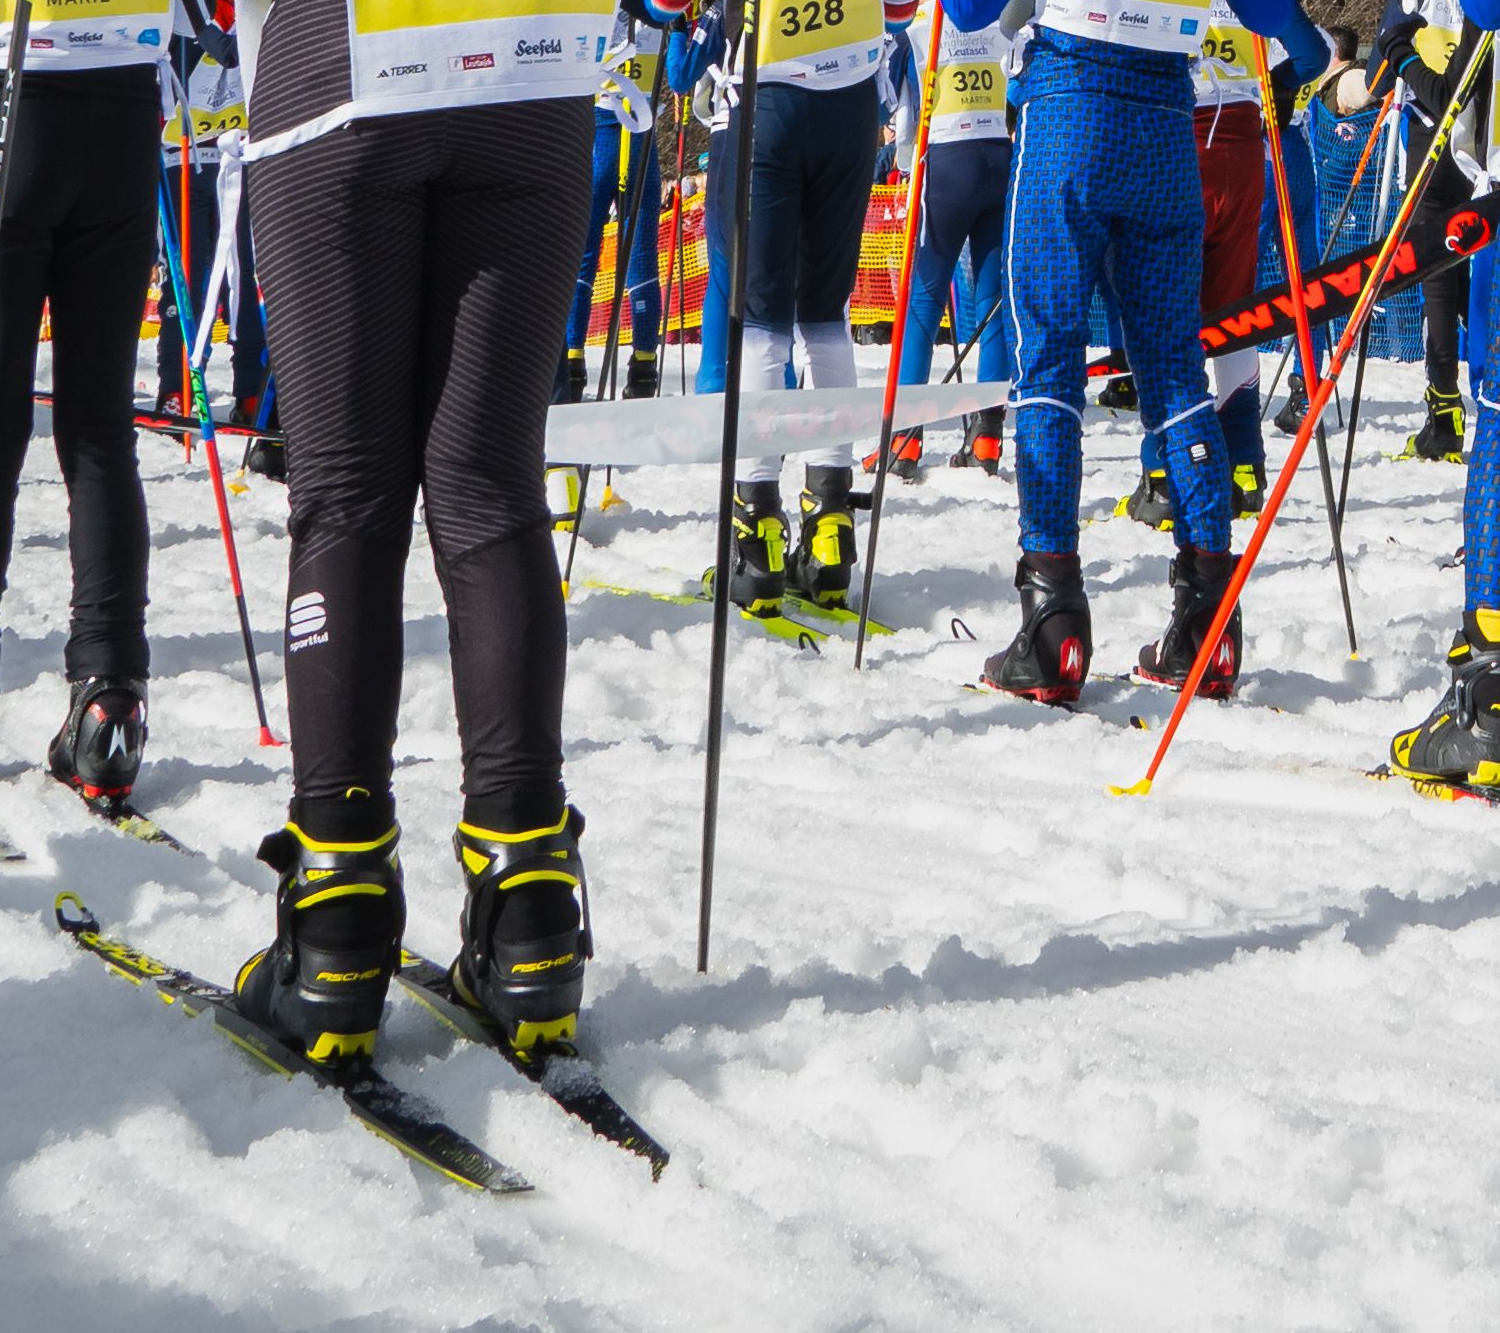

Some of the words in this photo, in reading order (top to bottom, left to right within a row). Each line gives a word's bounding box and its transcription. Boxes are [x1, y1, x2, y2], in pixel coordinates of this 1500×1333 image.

[1118, 11, 1150, 25] Seefeld
[515, 39, 562, 57] Seefeld
[1201, 39, 1237, 64] 25
[390, 63, 428, 77] TERREX
[952, 68, 994, 93] 320
[289, 631, 329, 652] sportful
[510, 952, 575, 974] FISCHER
[315, 967, 381, 982] FISCHER
